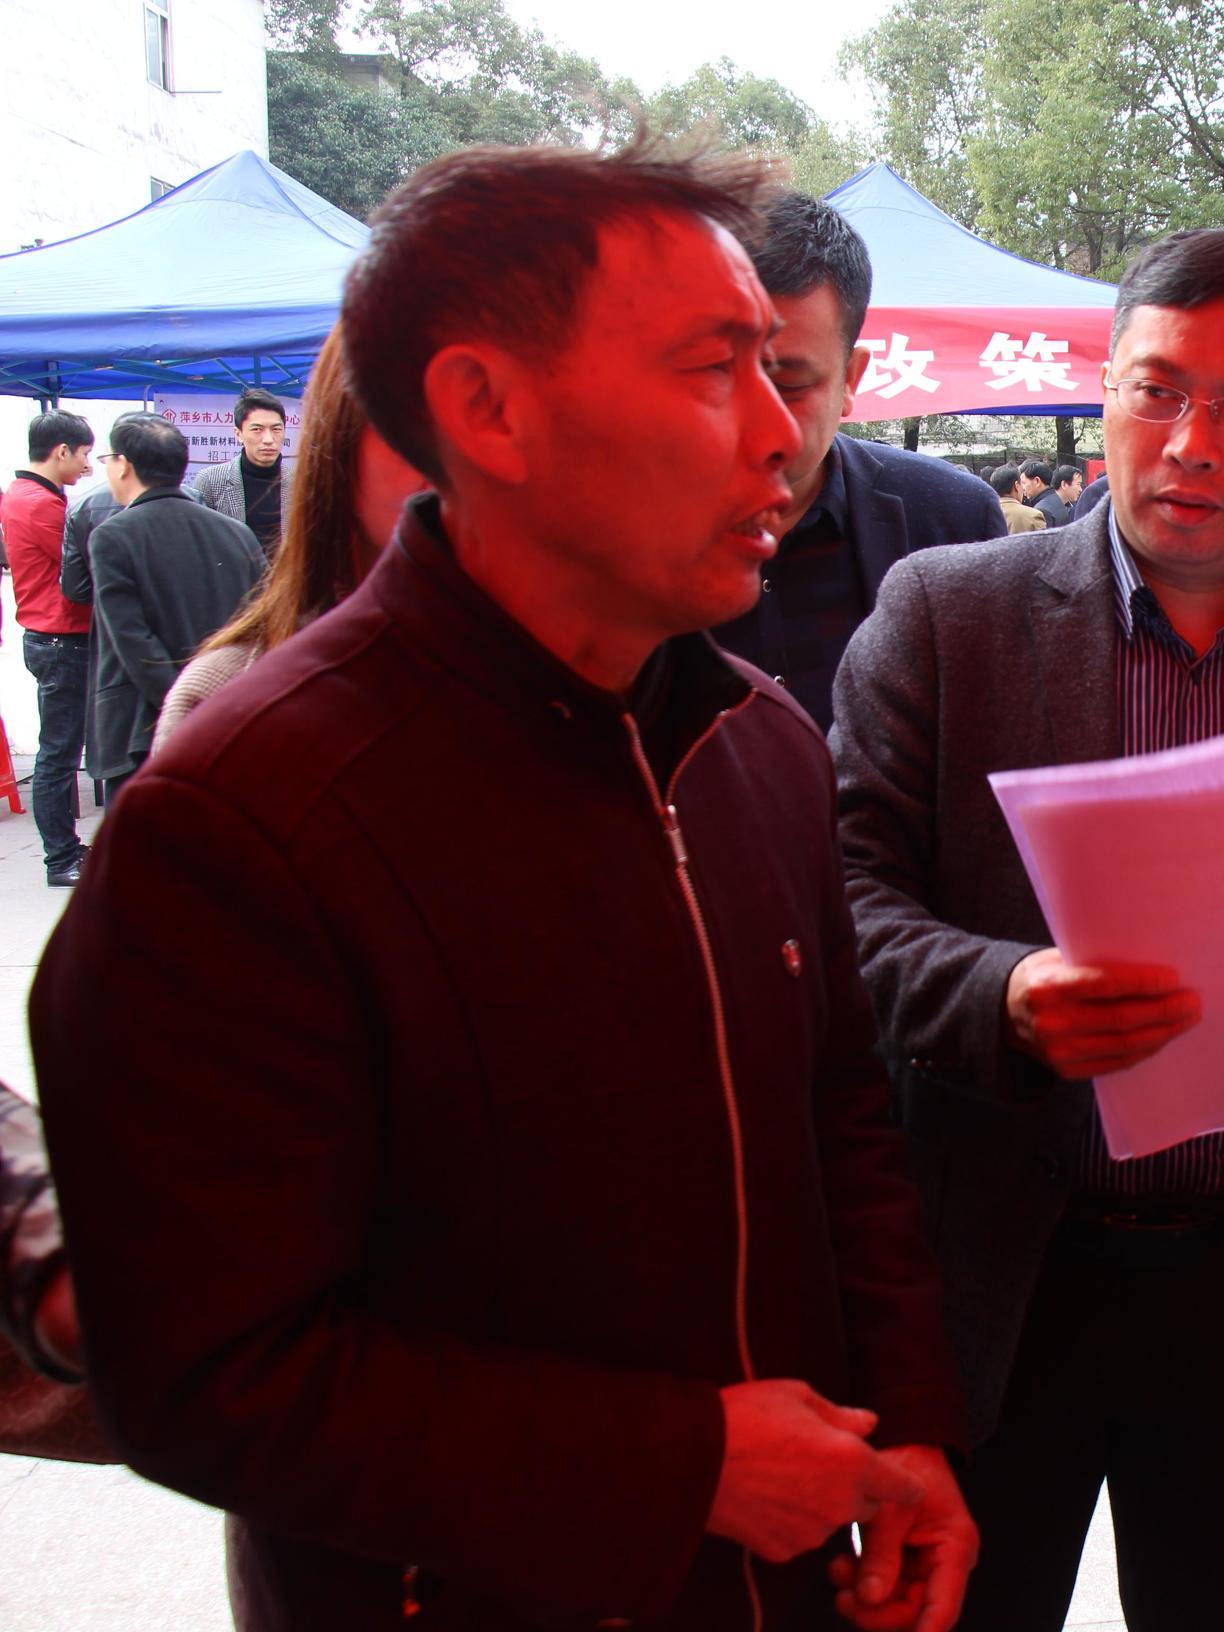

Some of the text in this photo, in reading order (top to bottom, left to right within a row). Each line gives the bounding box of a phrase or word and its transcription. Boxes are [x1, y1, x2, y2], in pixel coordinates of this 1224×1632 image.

[854, 332, 1080, 399] 政策
[180, 411, 234, 424] 萍乡市人力
